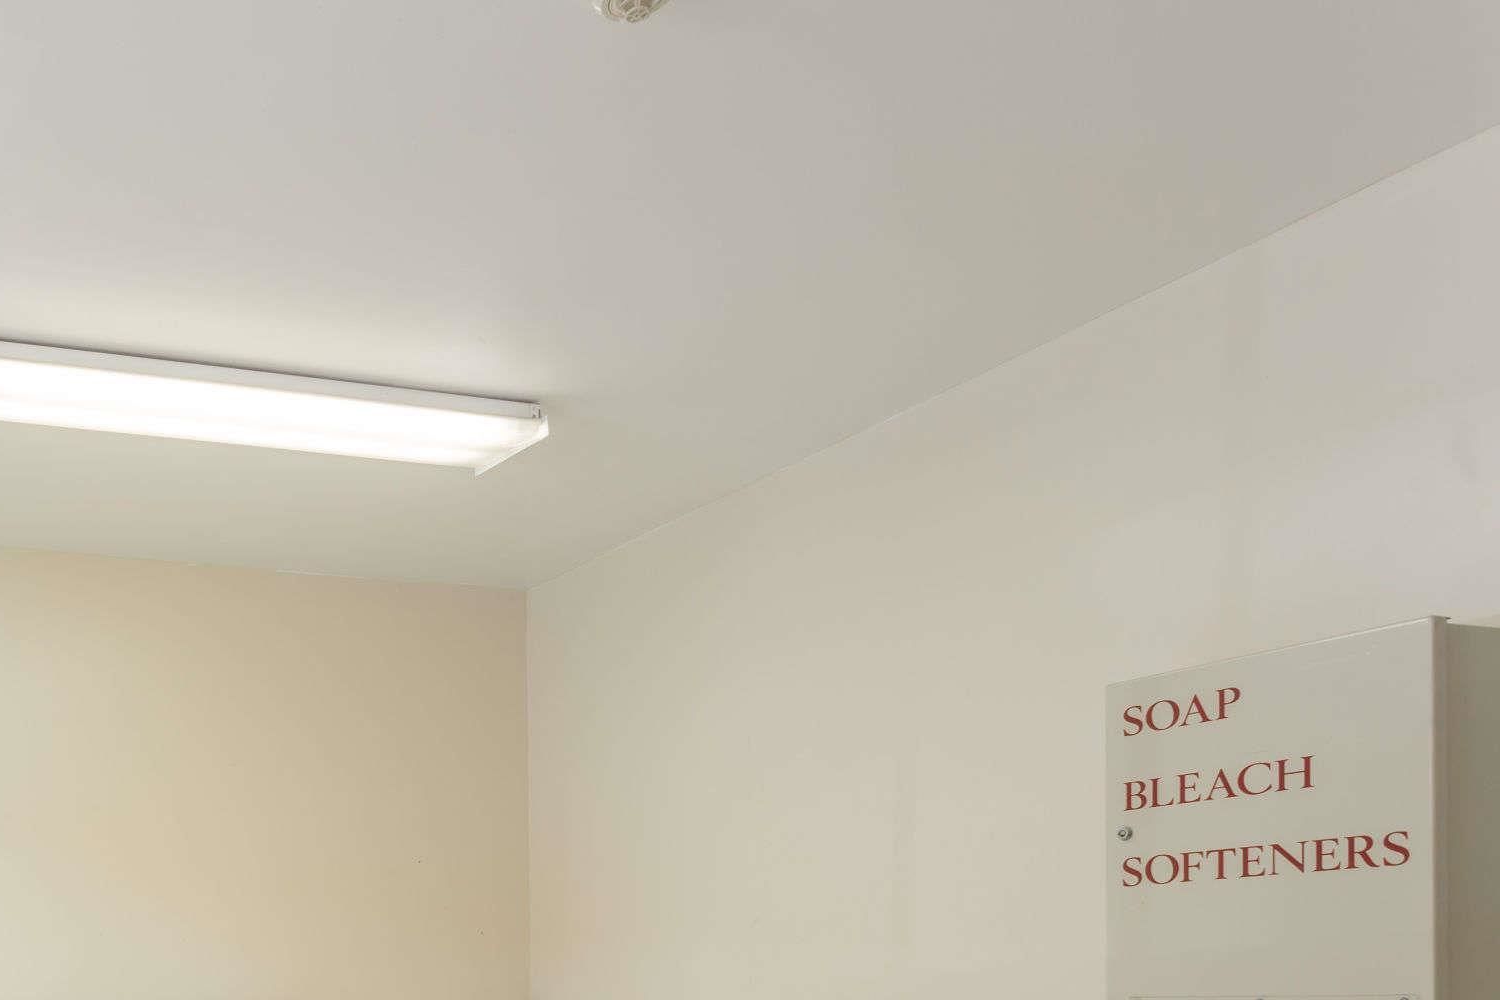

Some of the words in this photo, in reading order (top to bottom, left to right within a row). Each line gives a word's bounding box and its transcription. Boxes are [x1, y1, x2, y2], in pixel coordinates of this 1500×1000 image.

[1123, 687, 1241, 737] SOAP
[1123, 755, 1316, 812] BLEACH
[1122, 831, 1411, 887] SOFTENERS
